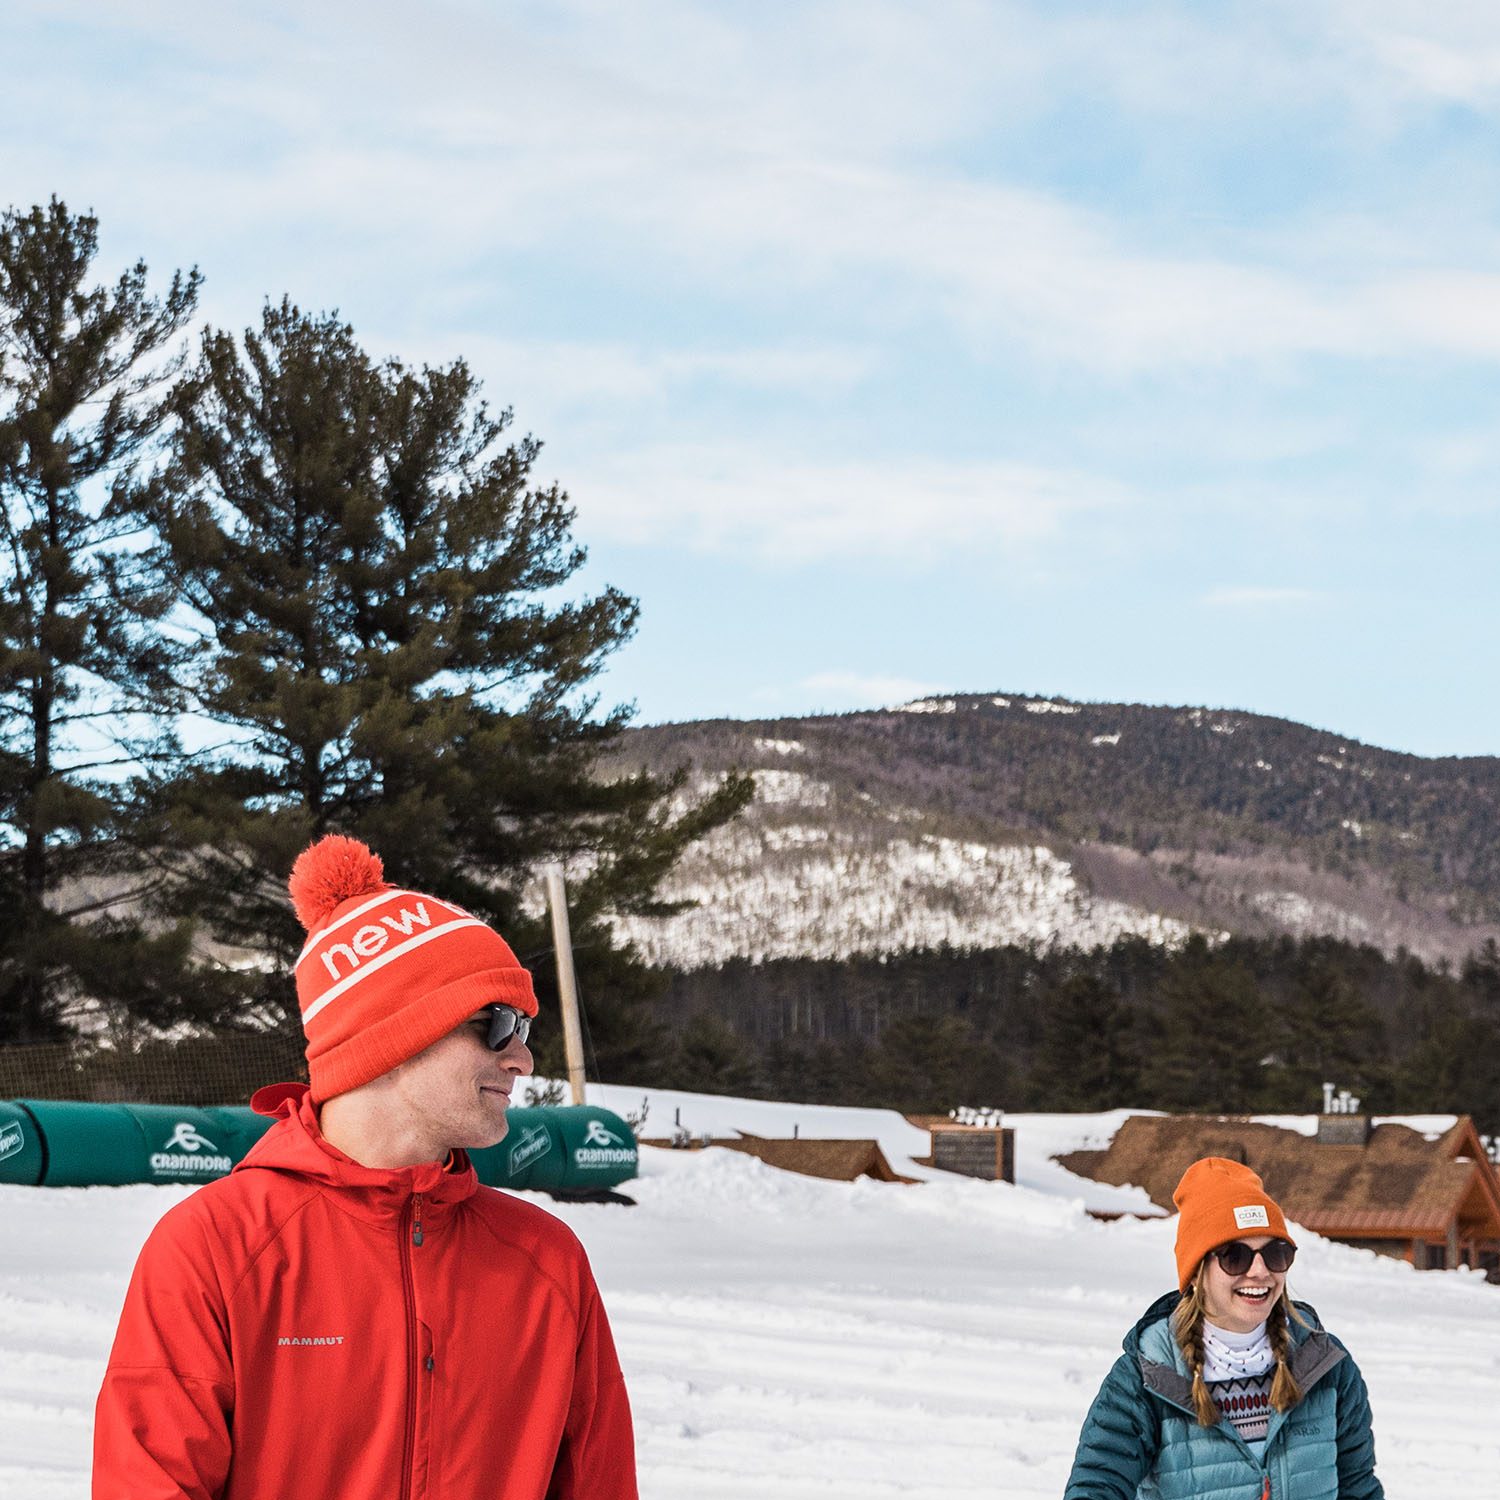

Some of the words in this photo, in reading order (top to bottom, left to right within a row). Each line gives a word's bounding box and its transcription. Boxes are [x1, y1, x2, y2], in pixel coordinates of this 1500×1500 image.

[320, 902, 431, 981] new
[1239, 1211, 1264, 1220] COAL
[278, 1336, 344, 1346] MAMMUT
[1301, 1424, 1321, 1437] Rab
